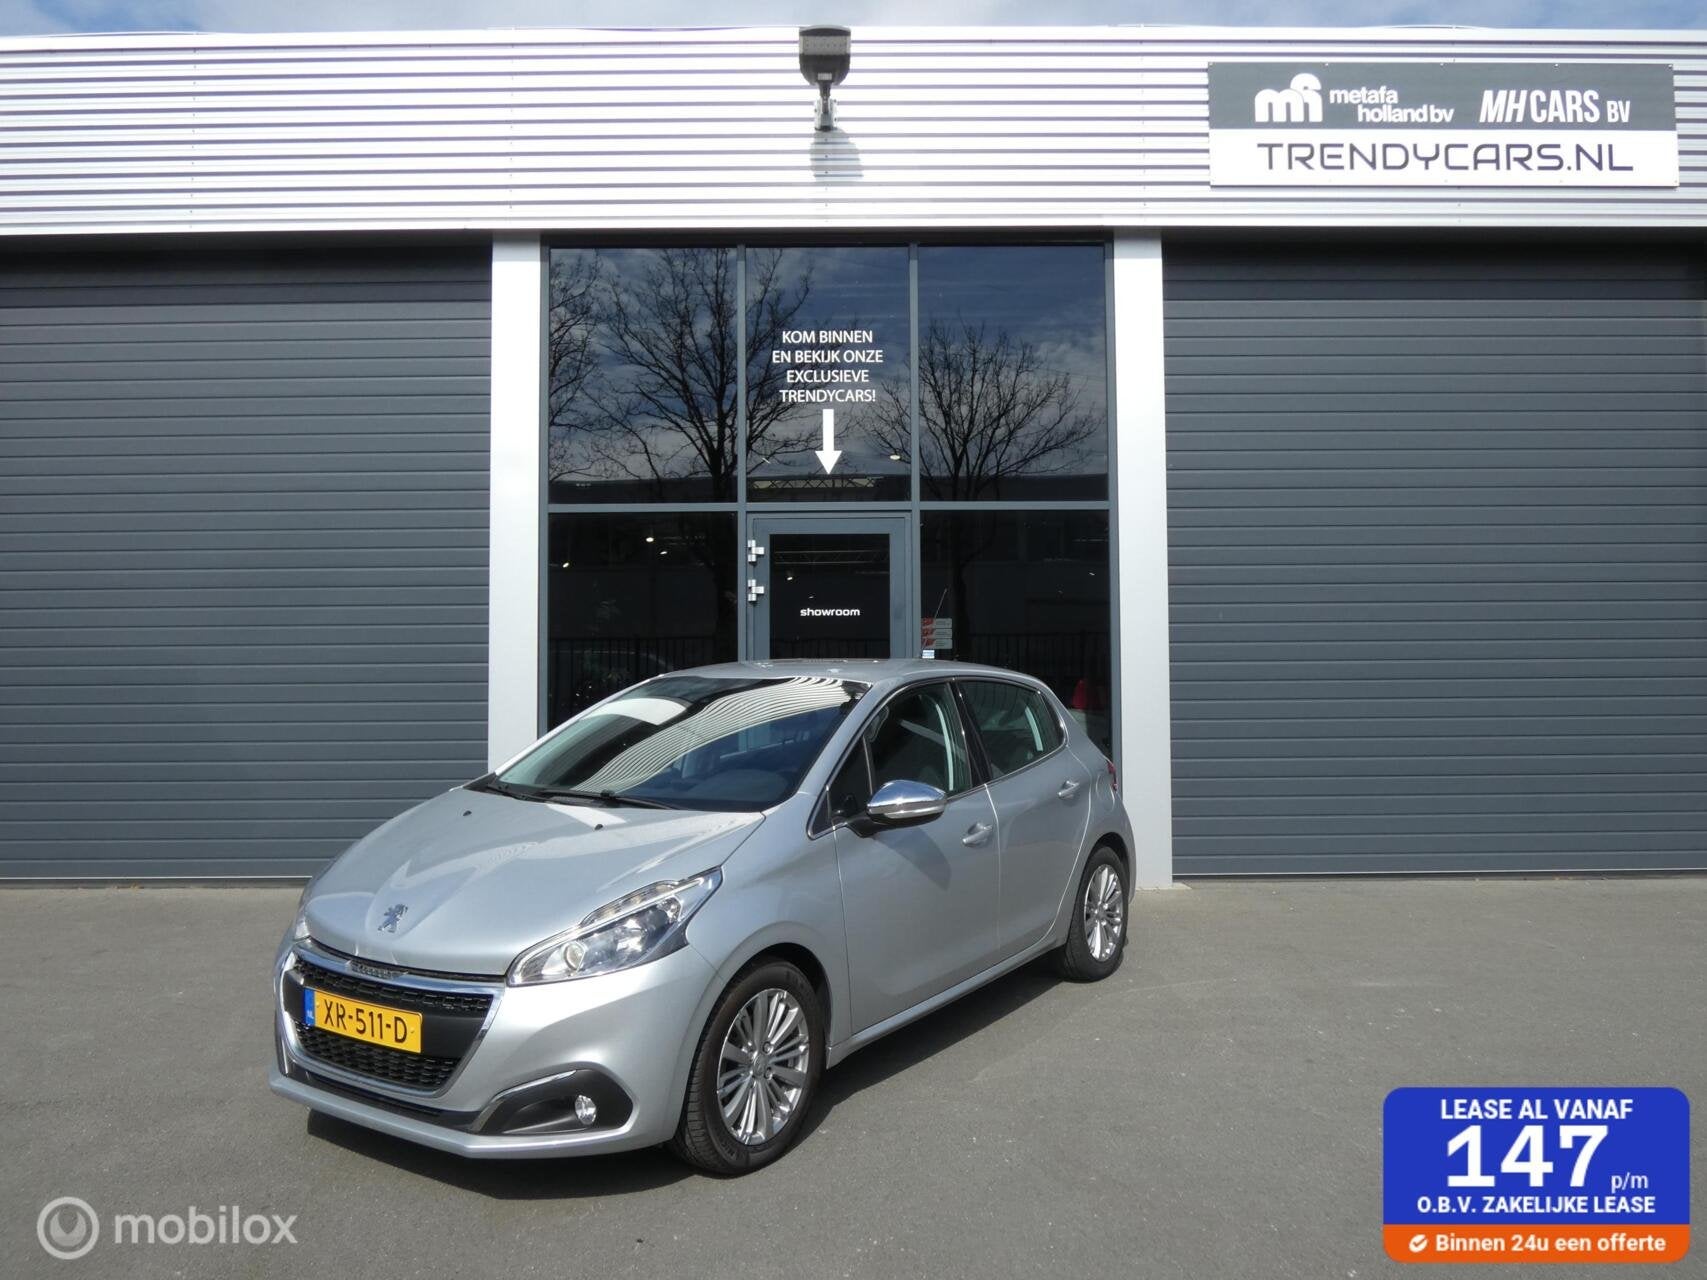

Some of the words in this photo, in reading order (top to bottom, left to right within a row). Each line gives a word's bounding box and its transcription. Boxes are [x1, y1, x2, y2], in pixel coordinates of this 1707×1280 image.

[1330, 86, 1398, 103] metafa
[1607, 101, 1630, 122] BV
[1257, 142, 1634, 171] TRENDYCARS.NL
[782, 331, 816, 343] KOM
[819, 330, 872, 343] BINNEN
[772, 351, 791, 363] EN
[795, 350, 840, 363] BEKIJK
[843, 350, 883, 363] ONZE
[786, 370, 869, 383] EXCLUSIEVE
[779, 389, 876, 402] TRENDYCARS!
[800, 608, 860, 617] showroom
[324, 999, 408, 1043] XR-511-D
